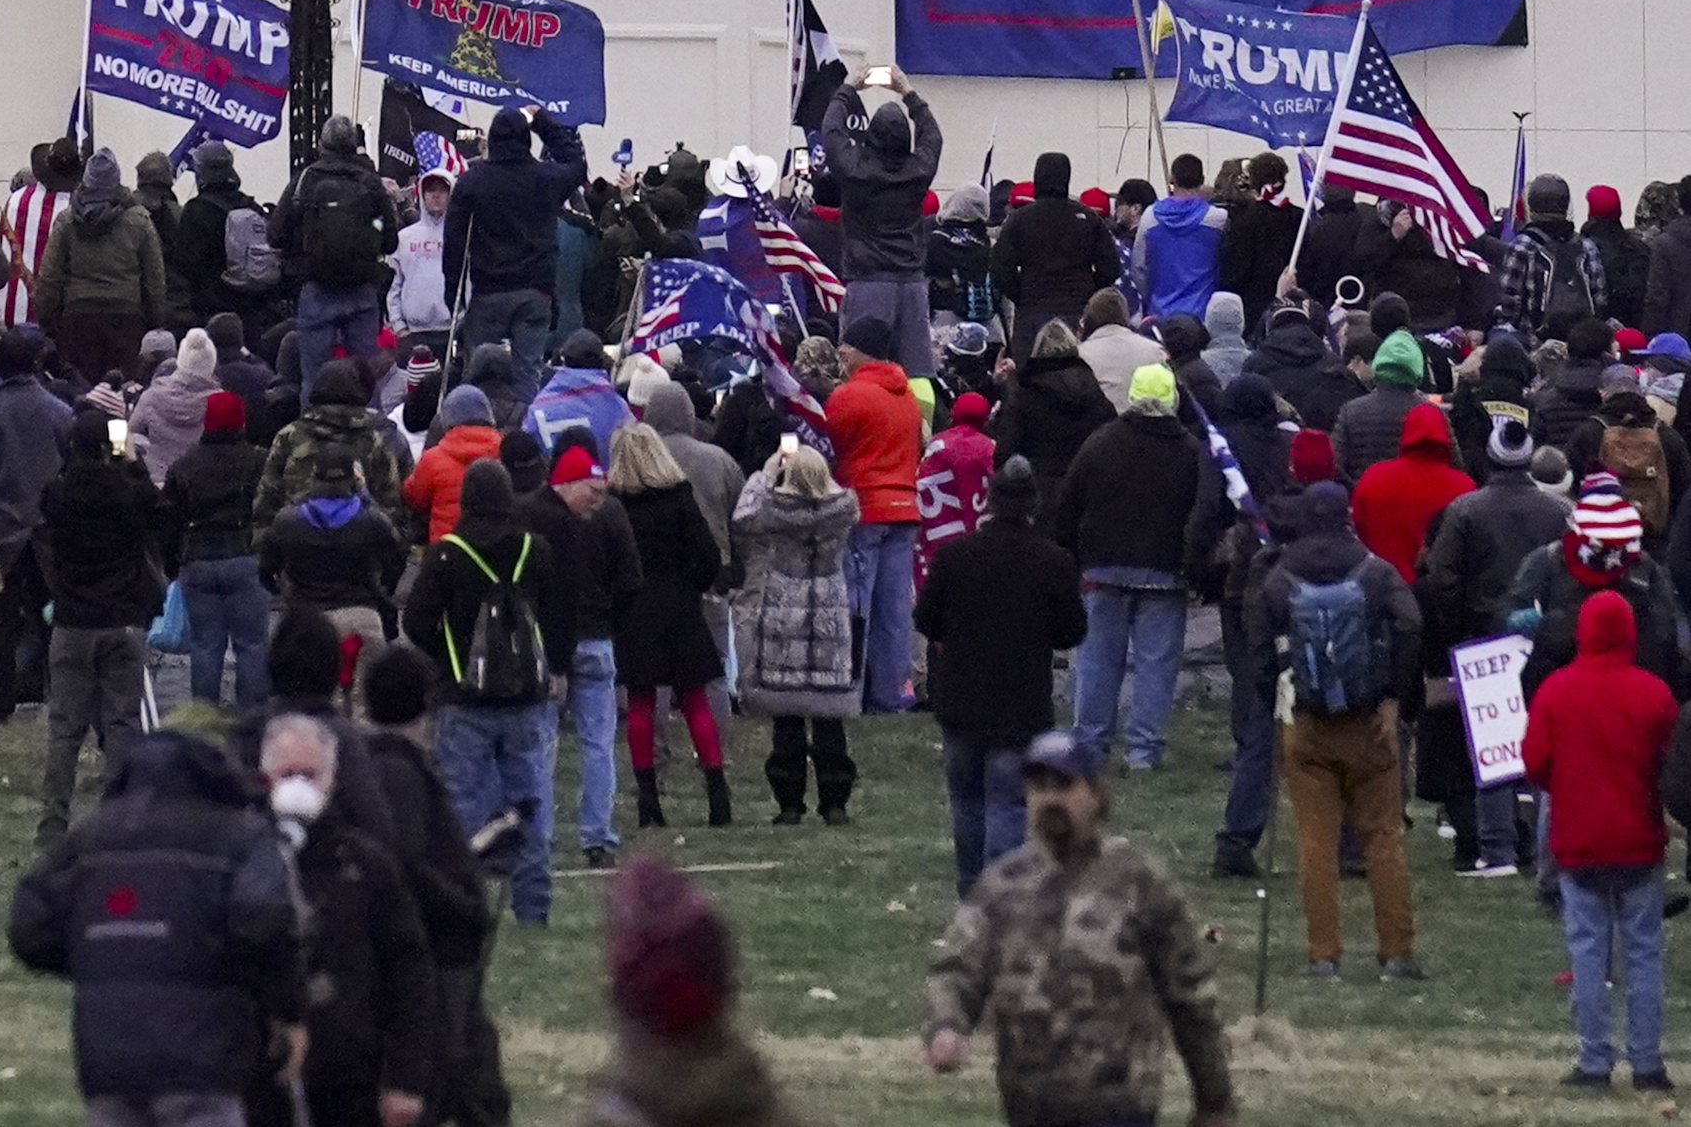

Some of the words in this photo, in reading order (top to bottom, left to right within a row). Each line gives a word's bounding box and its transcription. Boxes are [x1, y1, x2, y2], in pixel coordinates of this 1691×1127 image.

[388, 53, 433, 75] KEEP
[436, 70, 511, 98] AMERICA
[515, 88, 570, 113] GAT
[194, 81, 276, 135] BULLSHIT
[1273, 97, 1322, 116] GREAT
[644, 322, 700, 352] KEEP
[1461, 653, 1511, 680] KEEP
[1471, 704, 1498, 722] TO
